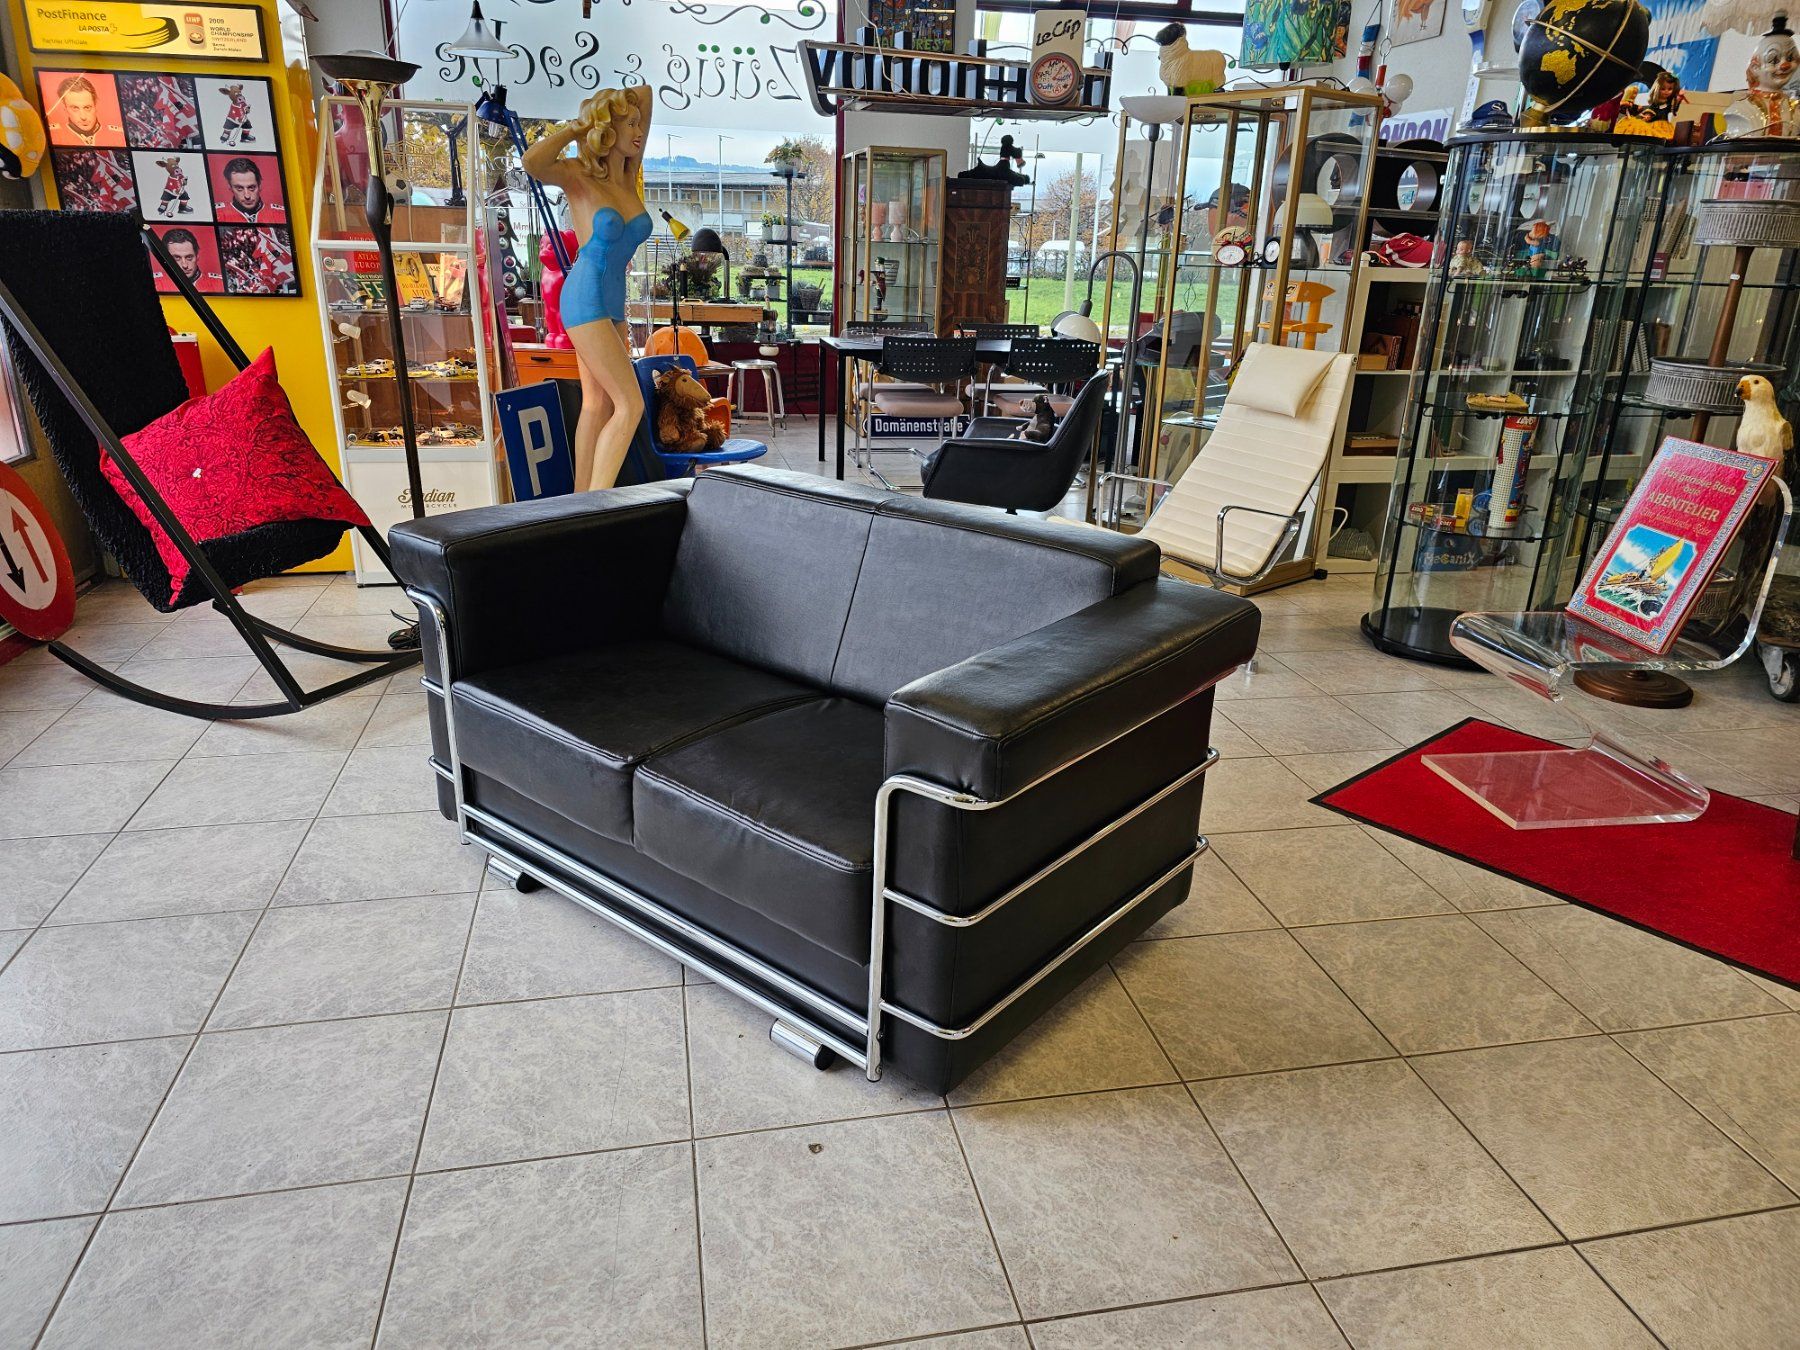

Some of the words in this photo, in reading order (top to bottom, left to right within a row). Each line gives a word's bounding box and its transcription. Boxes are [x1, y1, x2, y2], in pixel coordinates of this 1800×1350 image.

[37, 8, 107, 21] PostFinance
[1379, 118, 1448, 141] ONDON
[517, 405, 554, 497] P
[398, 488, 456, 504] Idian
[1648, 491, 1720, 523] ABENTEUER
